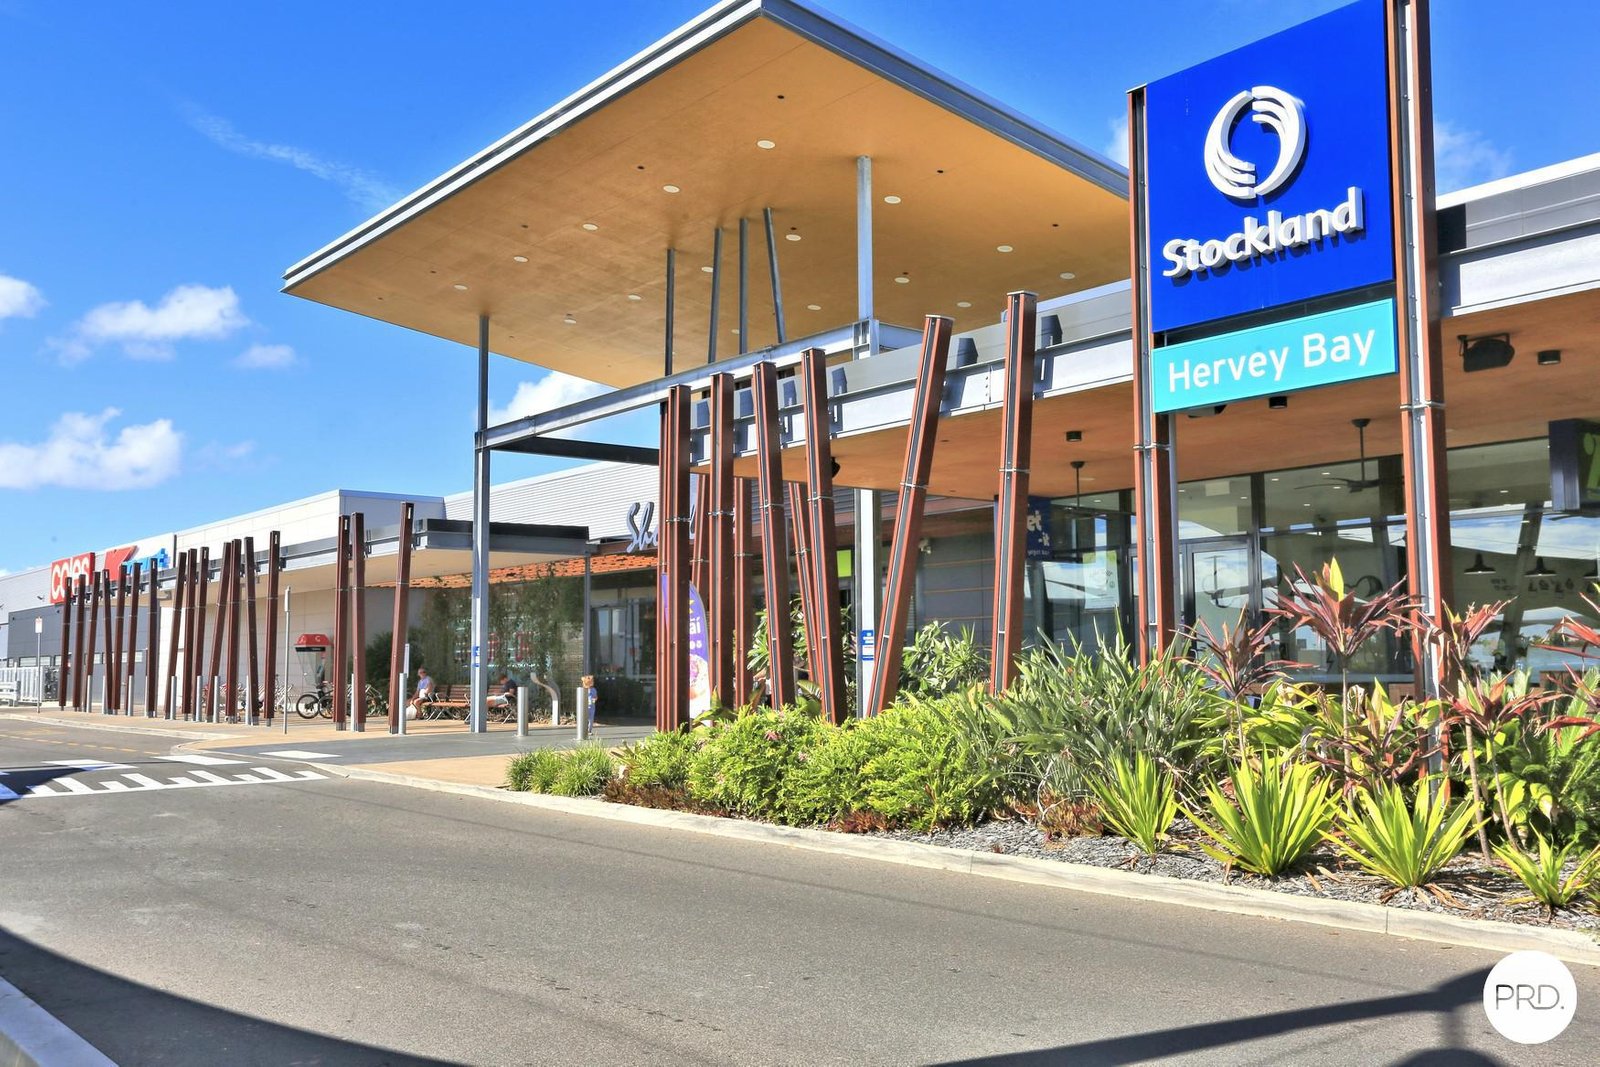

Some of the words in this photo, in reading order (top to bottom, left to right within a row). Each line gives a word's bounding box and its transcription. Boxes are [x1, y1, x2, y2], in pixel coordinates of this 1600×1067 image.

[1162, 186, 1364, 279] Stockland
[1168, 346, 1291, 393] Hervey
[1303, 328, 1376, 367] Bay
